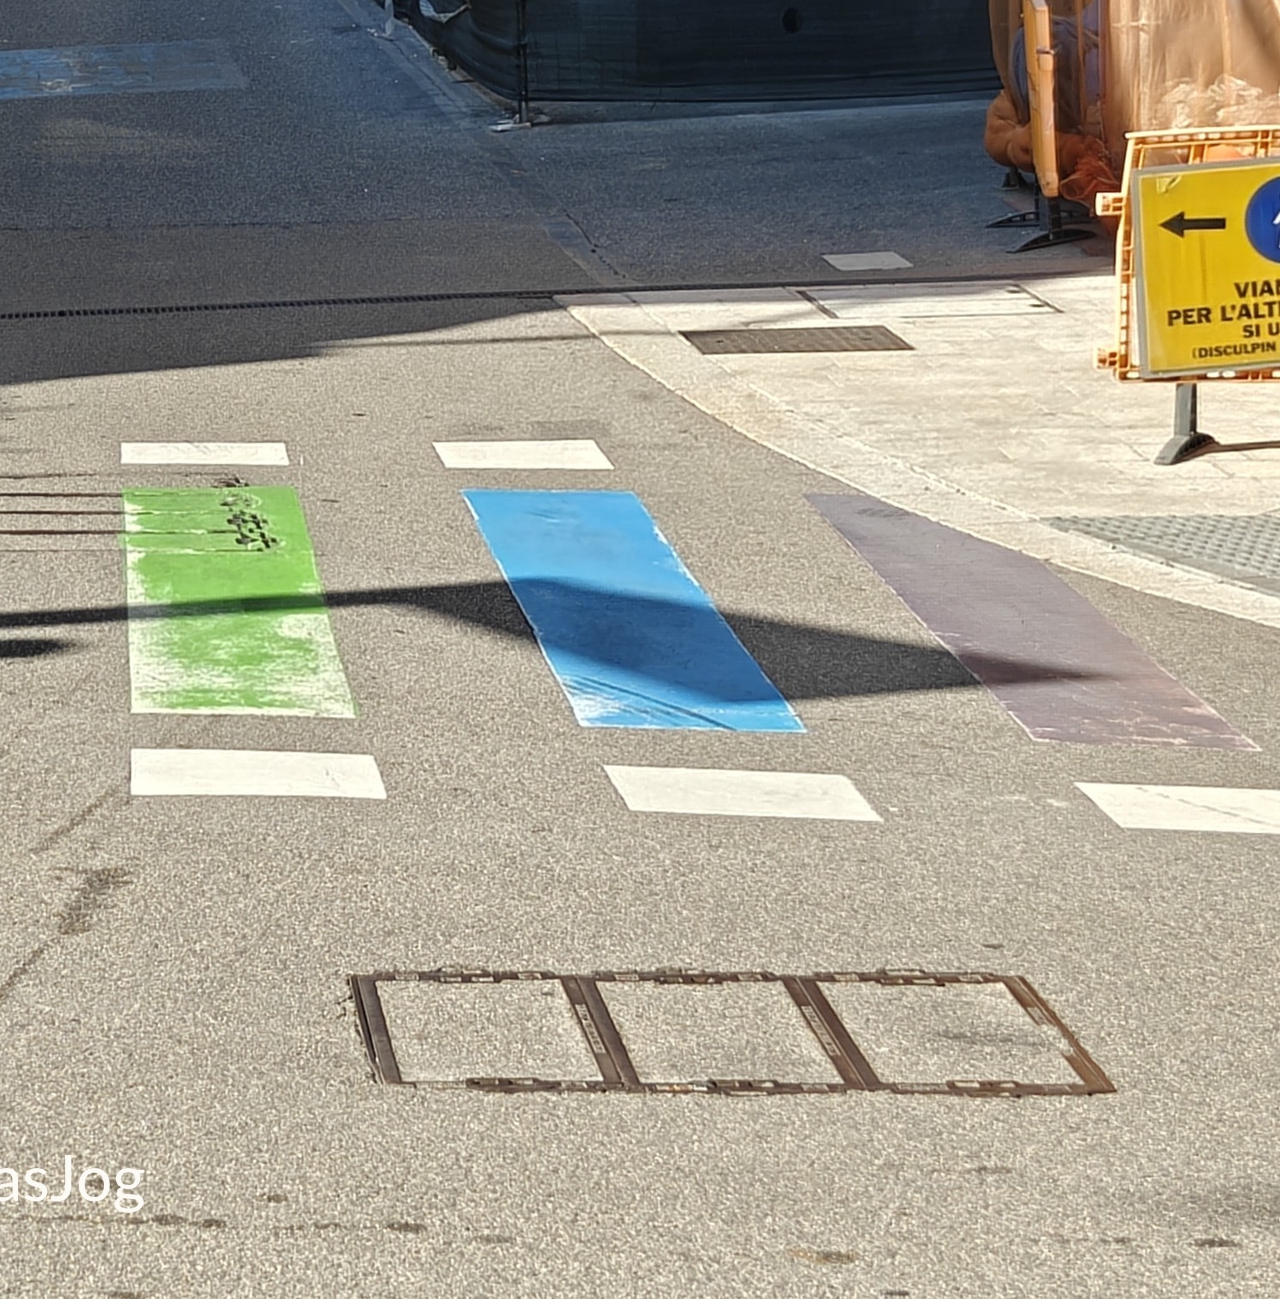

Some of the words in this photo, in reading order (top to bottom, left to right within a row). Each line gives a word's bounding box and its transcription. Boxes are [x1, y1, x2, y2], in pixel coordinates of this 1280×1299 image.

[1234, 278, 1280, 299] VIA
[1166, 306, 1212, 327] PER
[1220, 300, 1280, 322] L'ALT
[1242, 323, 1261, 339] SI
